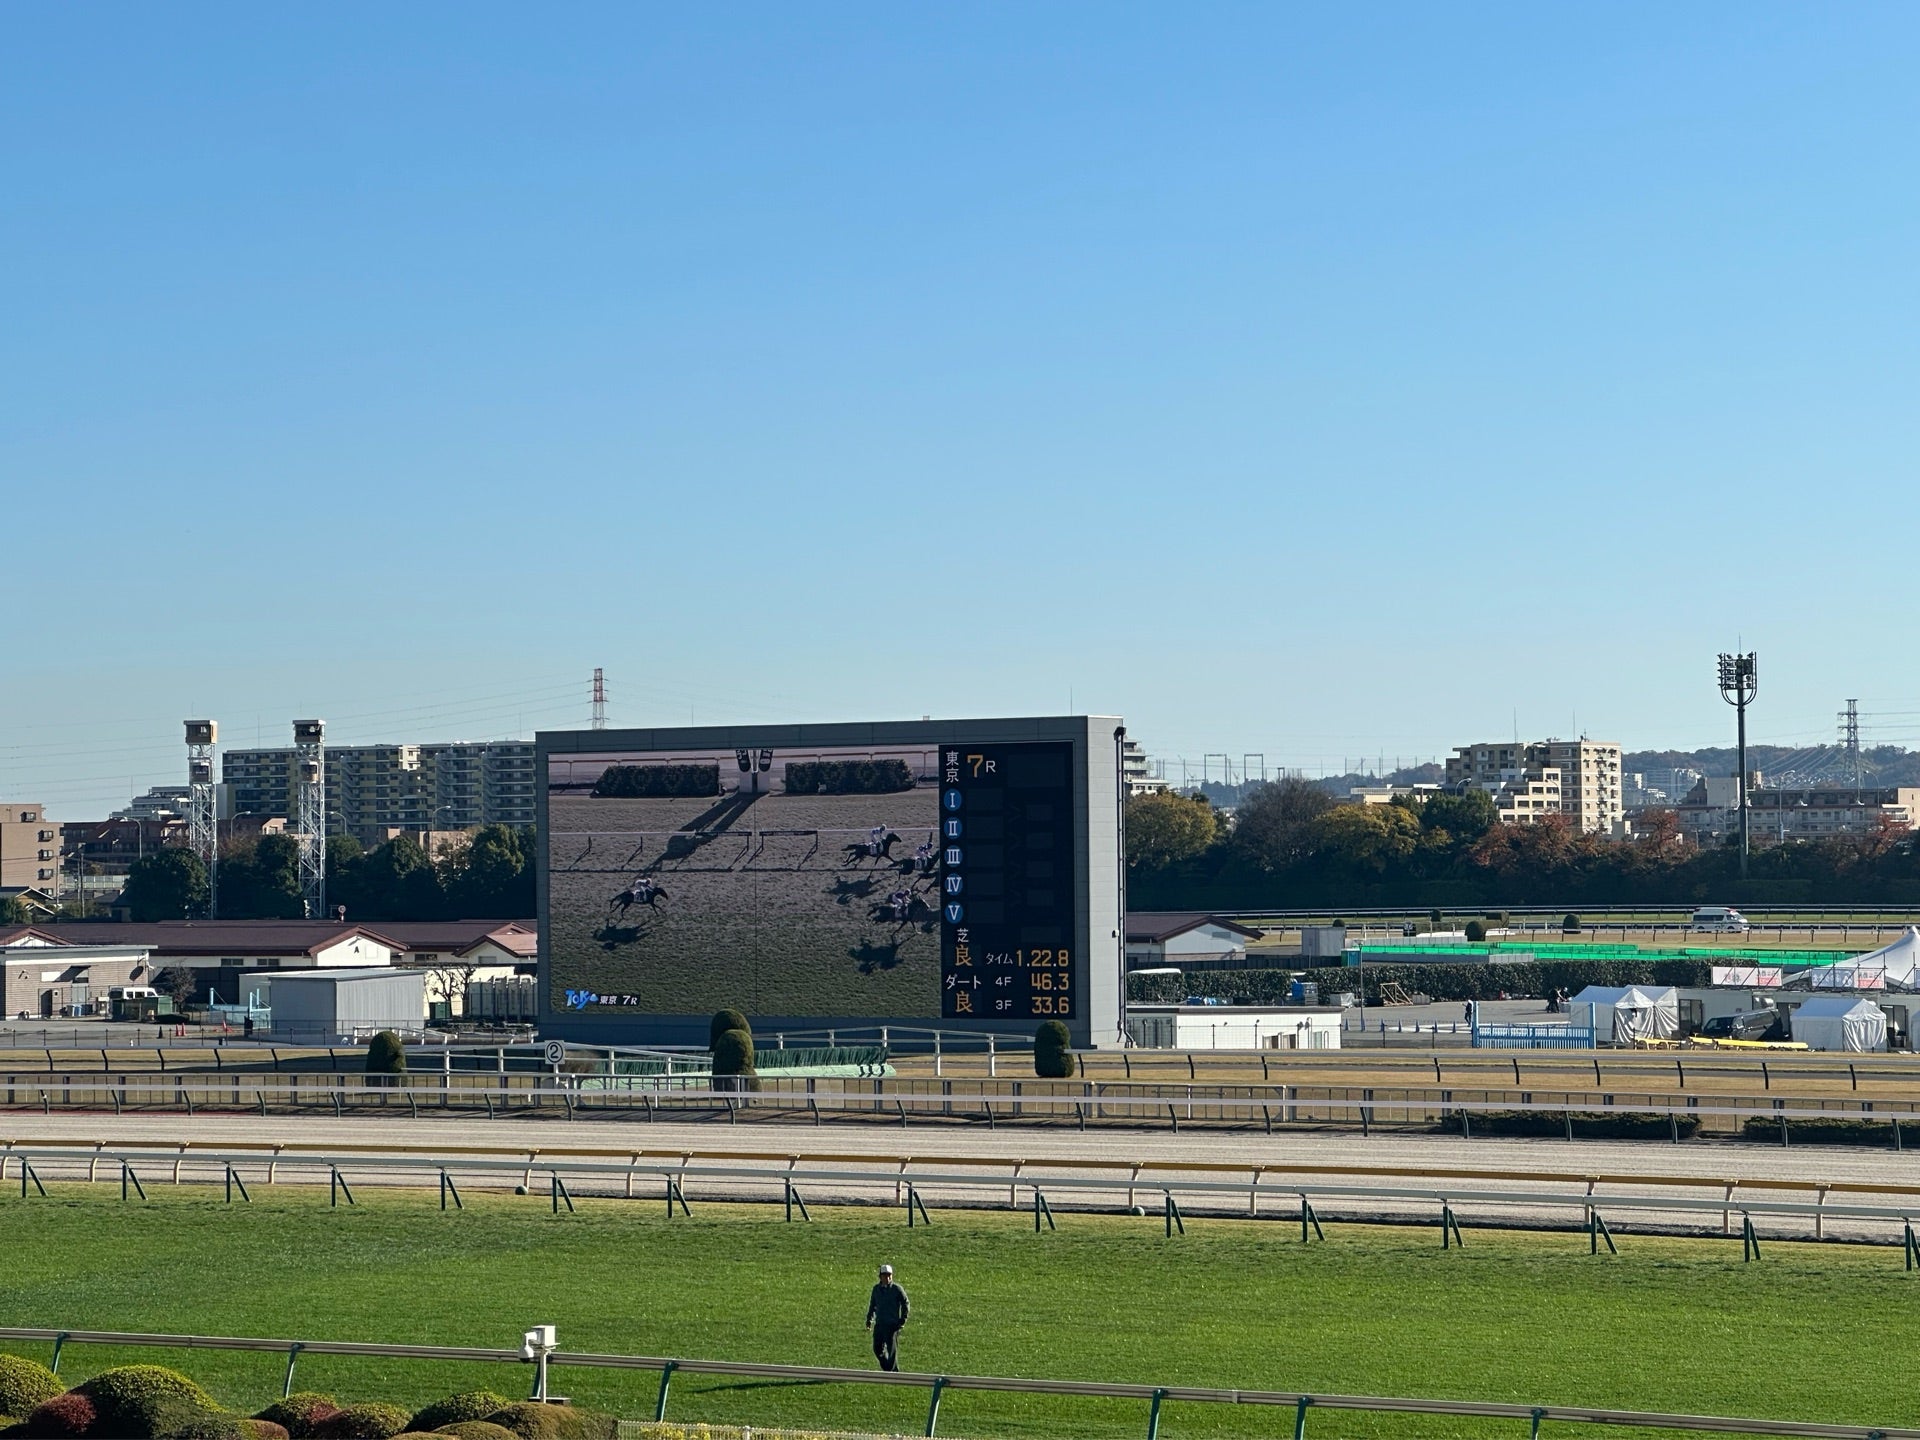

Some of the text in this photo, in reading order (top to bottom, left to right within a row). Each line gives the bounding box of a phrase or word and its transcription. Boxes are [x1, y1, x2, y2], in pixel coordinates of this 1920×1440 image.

[946, 751, 959, 783] 東京
[957, 928, 969, 943] 芝
[955, 944, 973, 967] 良
[985, 952, 1013, 965] タイム
[946, 974, 982, 990] ダート
[995, 973, 1069, 991] 4F 46.3
[600, 995, 617, 1005] 東京
[955, 990, 973, 1013] 良
[995, 996, 1069, 1014] 3F 33.6
